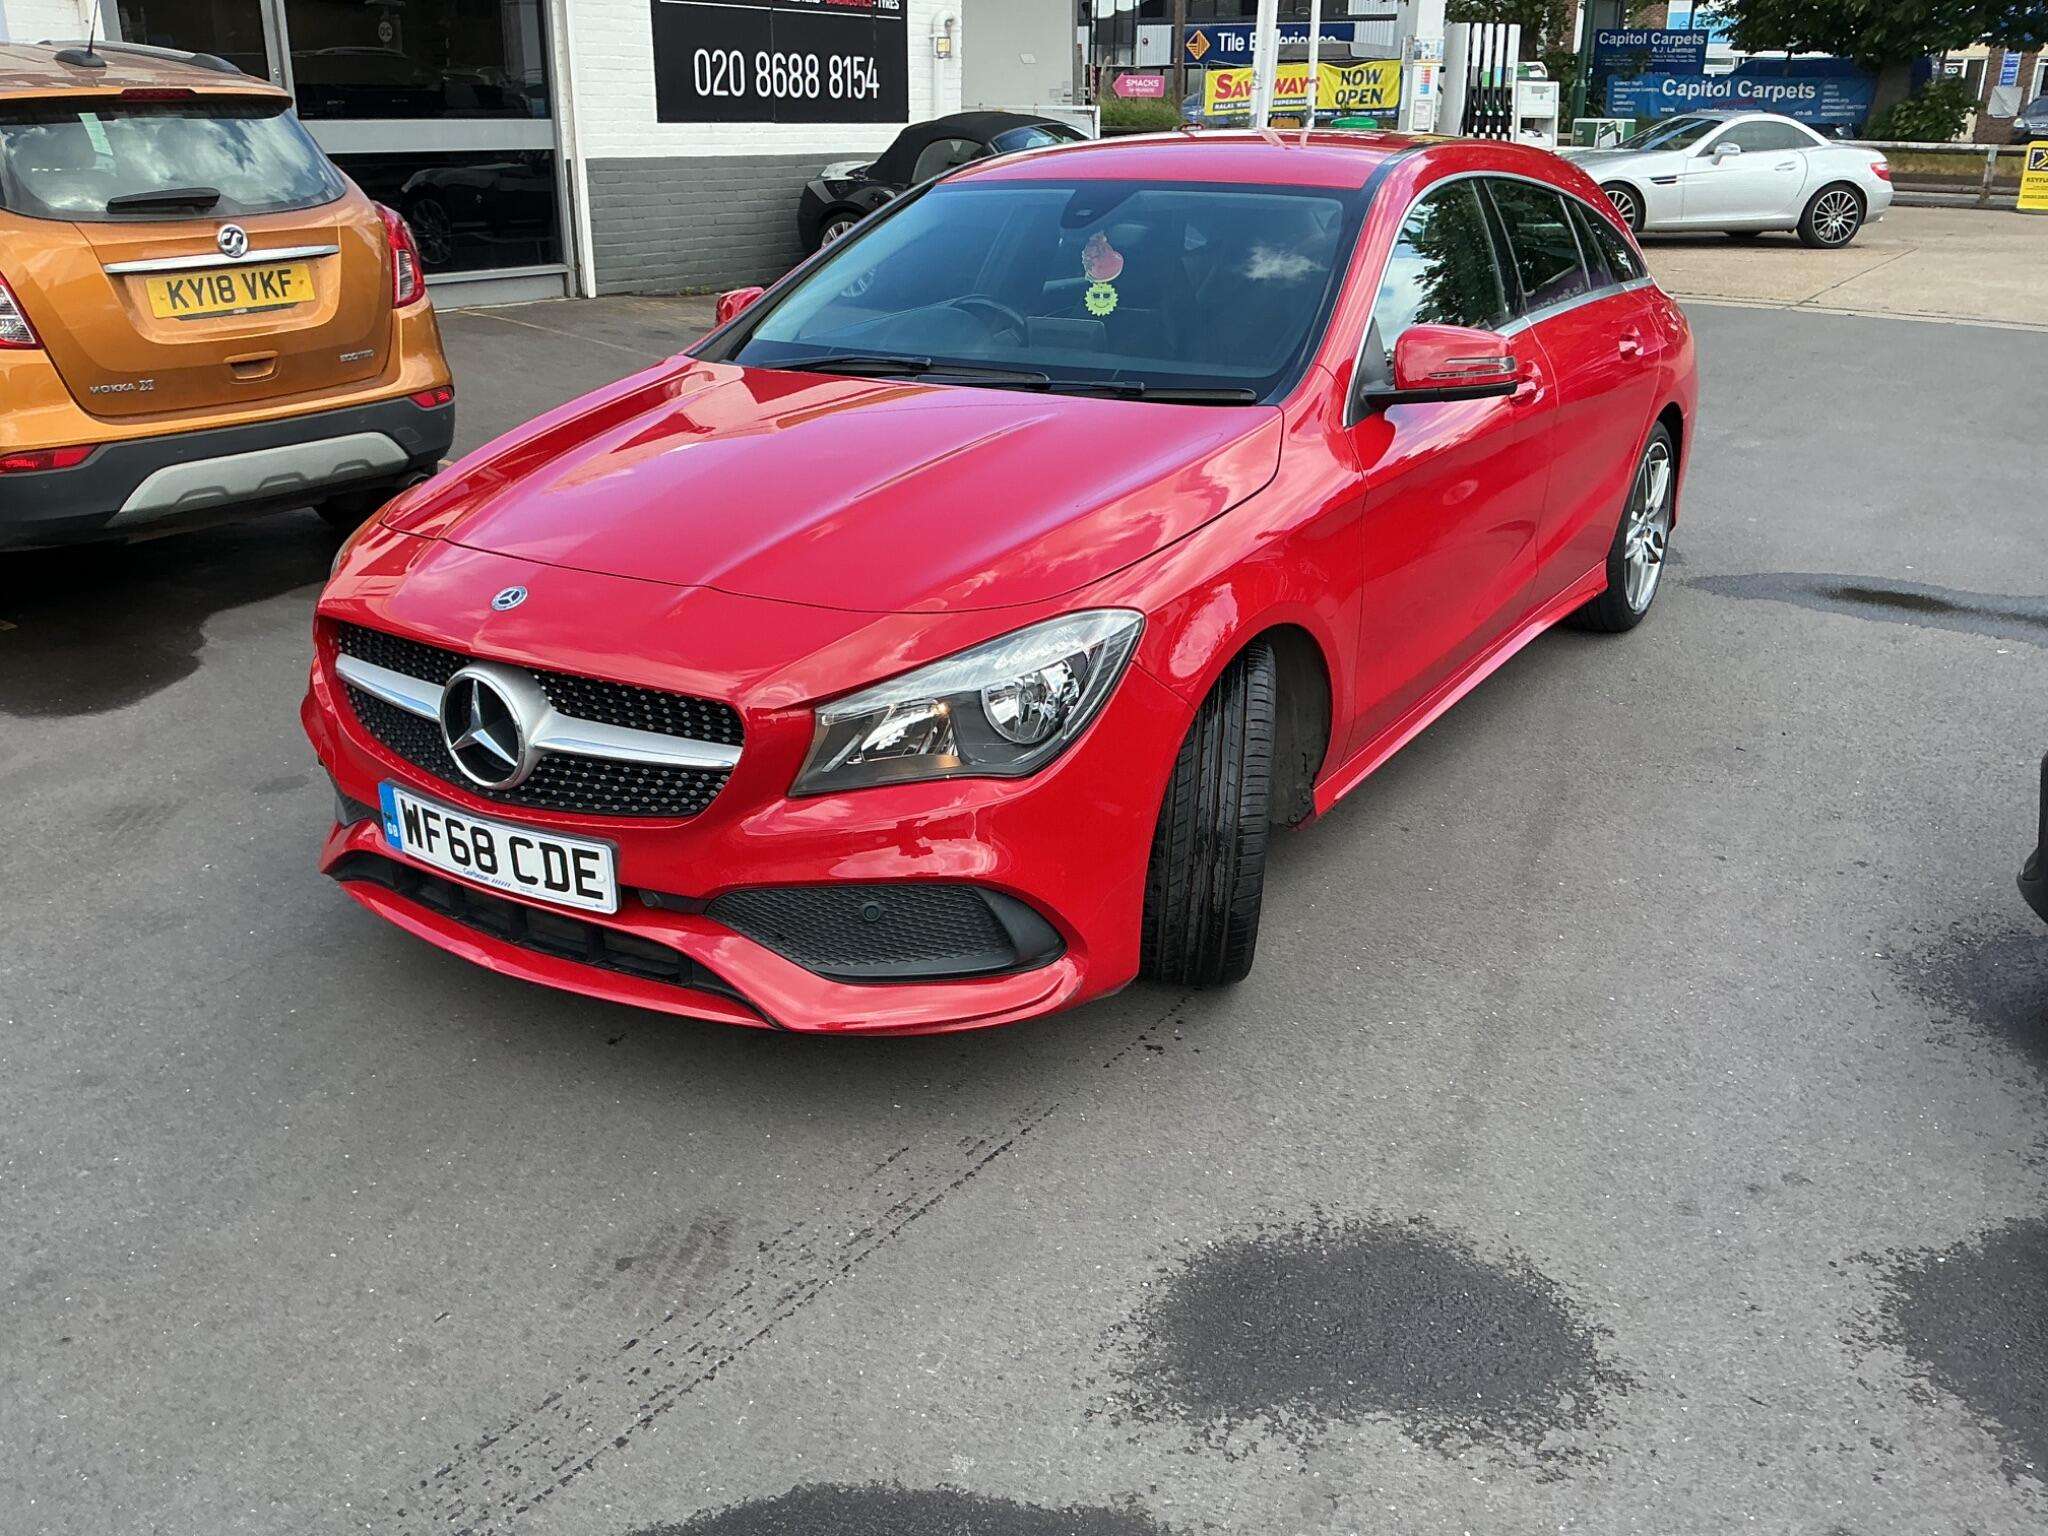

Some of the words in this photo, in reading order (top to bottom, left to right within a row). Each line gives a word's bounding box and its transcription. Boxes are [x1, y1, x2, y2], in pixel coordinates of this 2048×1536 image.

[1217, 32, 1245, 52] Tile
[1599, 32, 1647, 47] Capitol
[1651, 32, 1704, 47] Carpets
[693, 48, 746, 97] 020
[755, 51, 820, 99] 8688
[829, 54, 880, 99] 8154
[1126, 79, 1160, 87] SMACKS
[1340, 68, 1384, 86] NOW
[1335, 88, 1384, 105] OPEN
[1662, 79, 1731, 100] Capitol
[1737, 80, 1816, 102] Carpets
[166, 275, 236, 310] KY18
[241, 269, 292, 300] VKF
[400, 798, 499, 875] WF68
[508, 835, 604, 900] CDE
